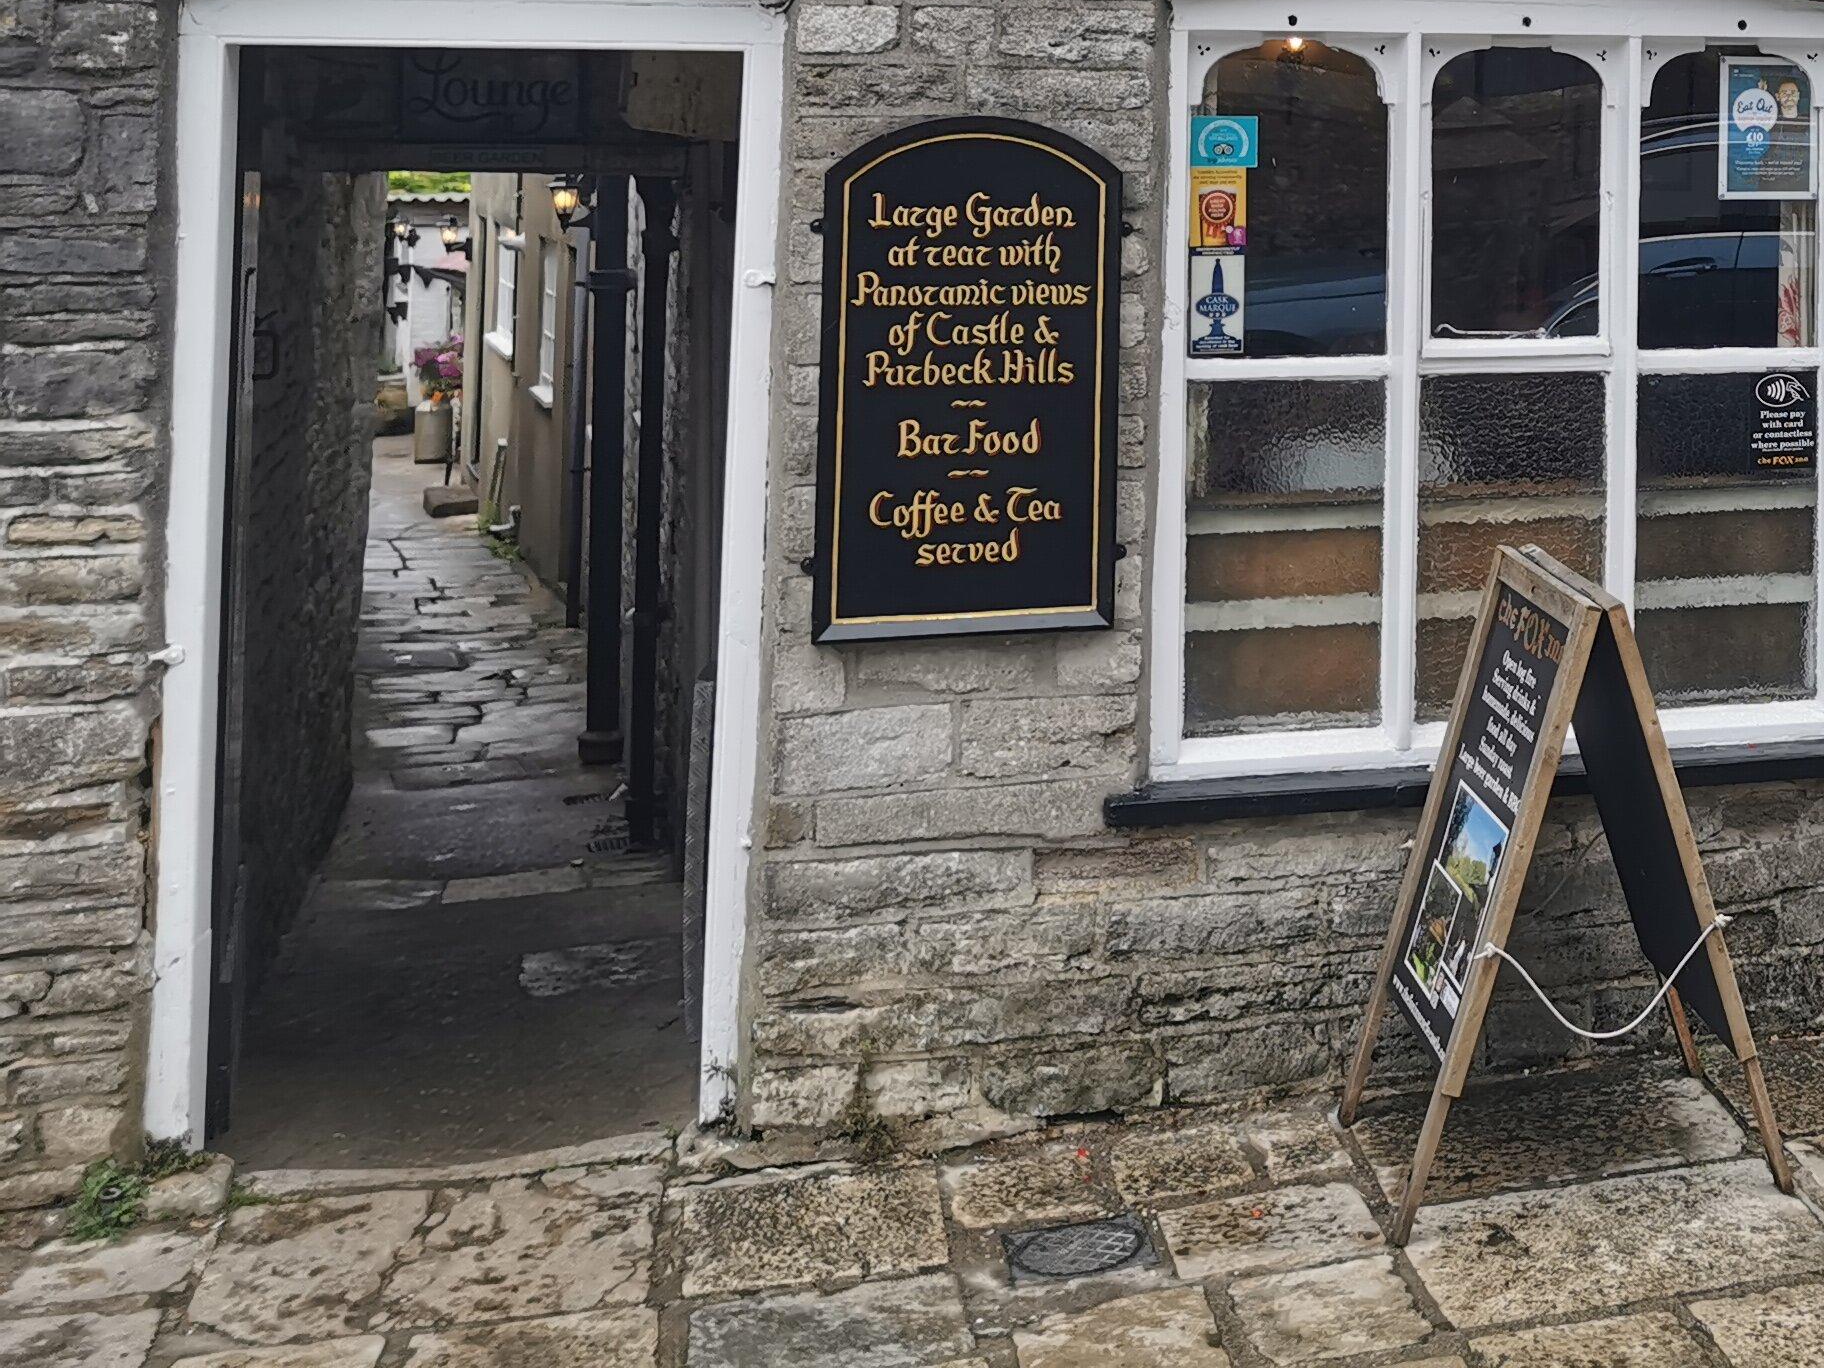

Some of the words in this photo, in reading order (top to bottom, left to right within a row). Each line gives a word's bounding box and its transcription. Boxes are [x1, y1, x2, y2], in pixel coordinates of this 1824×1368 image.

[408, 54, 574, 132] Lounge
[1738, 101, 1753, 113] Eat
[1756, 98, 1773, 113] Out
[1746, 132, 1763, 142] £10
[432, 150, 474, 164] BEER
[478, 151, 545, 165] GARDEN
[868, 191, 958, 237] Large
[965, 191, 1076, 237] Garden
[887, 237, 916, 267] at
[923, 244, 993, 267] rear
[999, 234, 1061, 273] with
[851, 271, 1006, 307] Panoramic
[1011, 280, 1092, 306] views
[1200, 304, 1236, 312] MARQUE
[1206, 296, 1229, 304] CASK
[887, 311, 922, 356] of
[926, 310, 1024, 346] Castle
[1034, 318, 1060, 345] &
[862, 348, 996, 388] Purbeck
[999, 348, 1075, 386] Hills
[1760, 411, 1788, 419] Please
[1762, 420, 1782, 428] with
[1784, 420, 1803, 428] card
[1764, 430, 1812, 438] contactless
[897, 419, 958, 459] Bar
[961, 418, 1042, 457] Food
[1751, 441, 1778, 449] where
[1780, 438, 1814, 449] possible
[1772, 456, 1794, 465] FOX
[869, 490, 965, 538] Coffee
[974, 495, 999, 524] &
[1005, 486, 1062, 524] Tea
[915, 527, 1021, 566] served
[1498, 593, 1519, 630] the
[1513, 606, 1551, 660] FOX
[1502, 649, 1518, 674] Open
[1516, 660, 1527, 684] log
[1491, 667, 1514, 700] Serving
[1511, 684, 1530, 712] drinks
[1529, 698, 1537, 717] &
[1481, 684, 1510, 724] homemade,
[1510, 710, 1535, 743] delicious
[1486, 716, 1501, 739] food
[1498, 728, 1508, 746] all
[1505, 733, 1518, 757] day
[1458, 742, 1475, 770] Large
[1473, 756, 1486, 781] beer
[1483, 772, 1504, 800] garden
[1502, 786, 1510, 805] &
[1478, 735, 1500, 768] Sunday
[1497, 757, 1514, 780] roast
